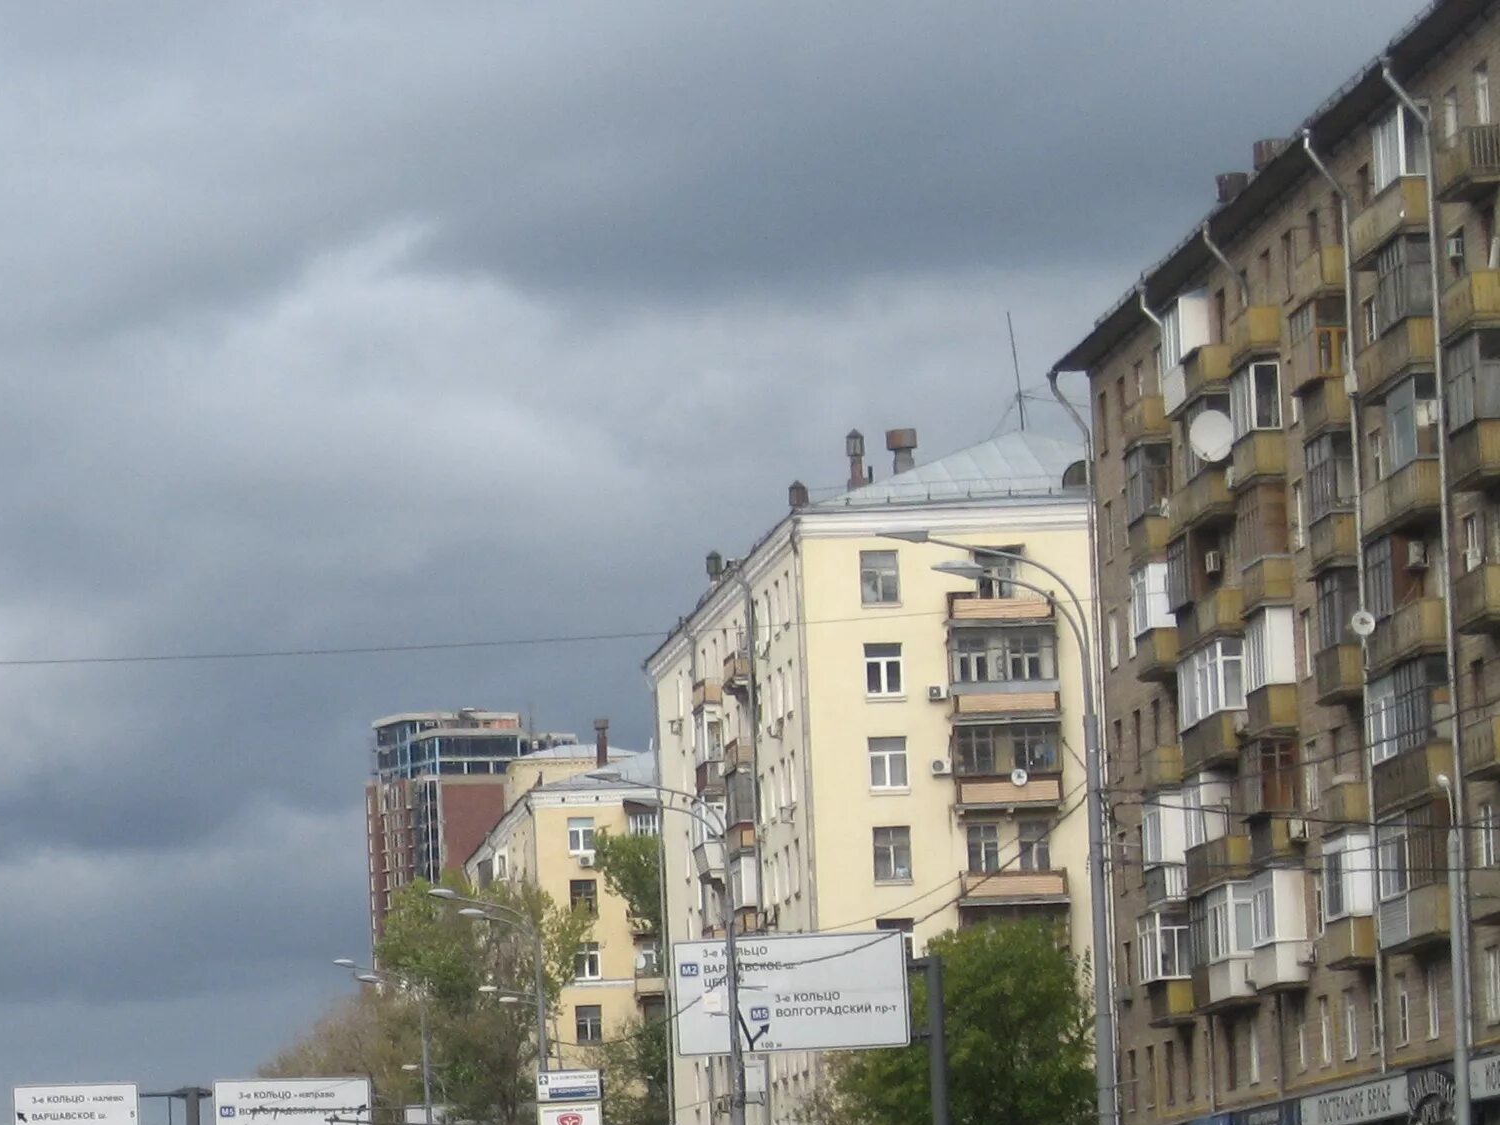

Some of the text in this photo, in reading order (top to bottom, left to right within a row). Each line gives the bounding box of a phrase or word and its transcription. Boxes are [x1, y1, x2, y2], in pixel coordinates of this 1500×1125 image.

[721, 946, 768, 957] КЛЬЦО
[703, 962, 783, 974] ВАРАВСКОЕ
[775, 991, 841, 1003] 3-е КОЛЬЦО
[775, 1002, 873, 1018] ВОЛГОГРАДСКИЙ
[875, 1005, 898, 1015] пр-т
[761, 1041, 774, 1049] 100
[46, 1095, 85, 1104] КОЛЬЦО
[253, 1091, 292, 1100] КОЛЬЦО
[299, 1092, 336, 1101] направо
[31, 1112, 96, 1121] ВАРШАВСКОЕ
